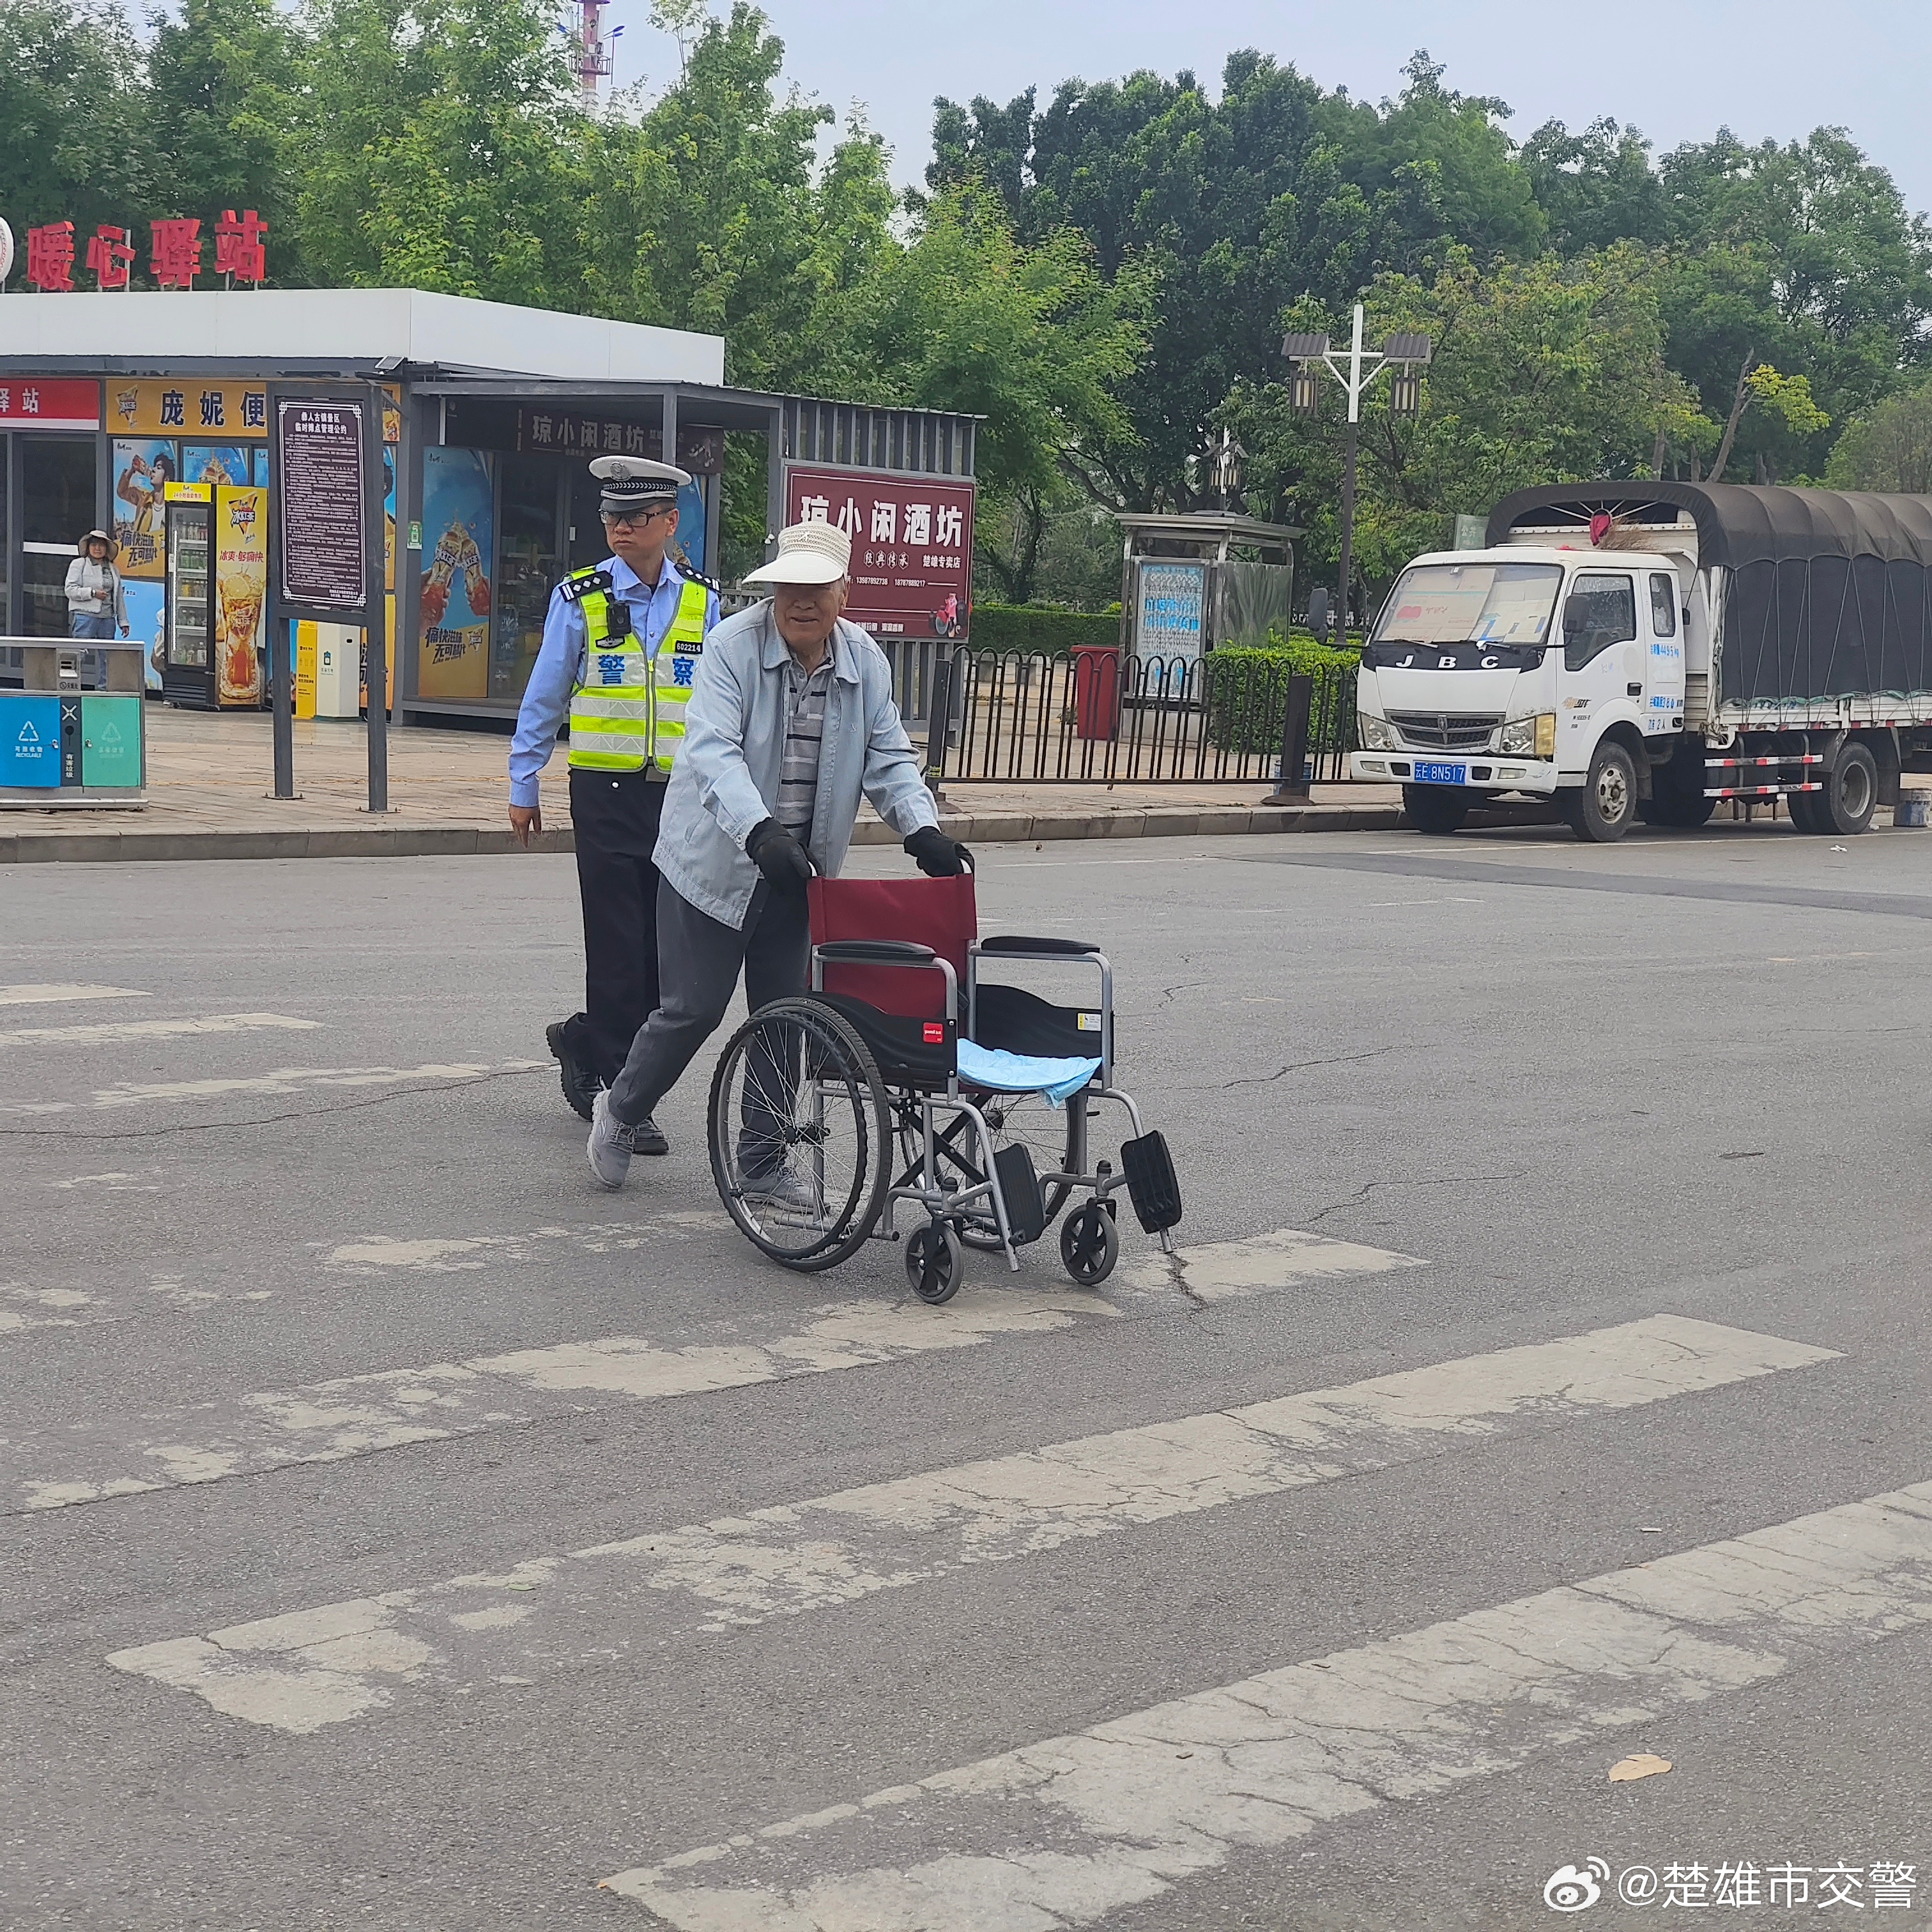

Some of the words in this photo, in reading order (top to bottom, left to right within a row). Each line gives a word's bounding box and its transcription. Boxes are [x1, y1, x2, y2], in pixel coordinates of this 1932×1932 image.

[27, 210, 268, 290] 暖心驿站
[160, 388, 266, 427] 庞妮便
[533, 415, 645, 454] 琼小闲酒坊
[923, 555, 961, 569] 楚雄专卖店
[677, 643, 701, 652] 602214
[598, 655, 625, 684] 警
[673, 657, 694, 686] 察
[66, 754, 74, 778] 有害垃圾
